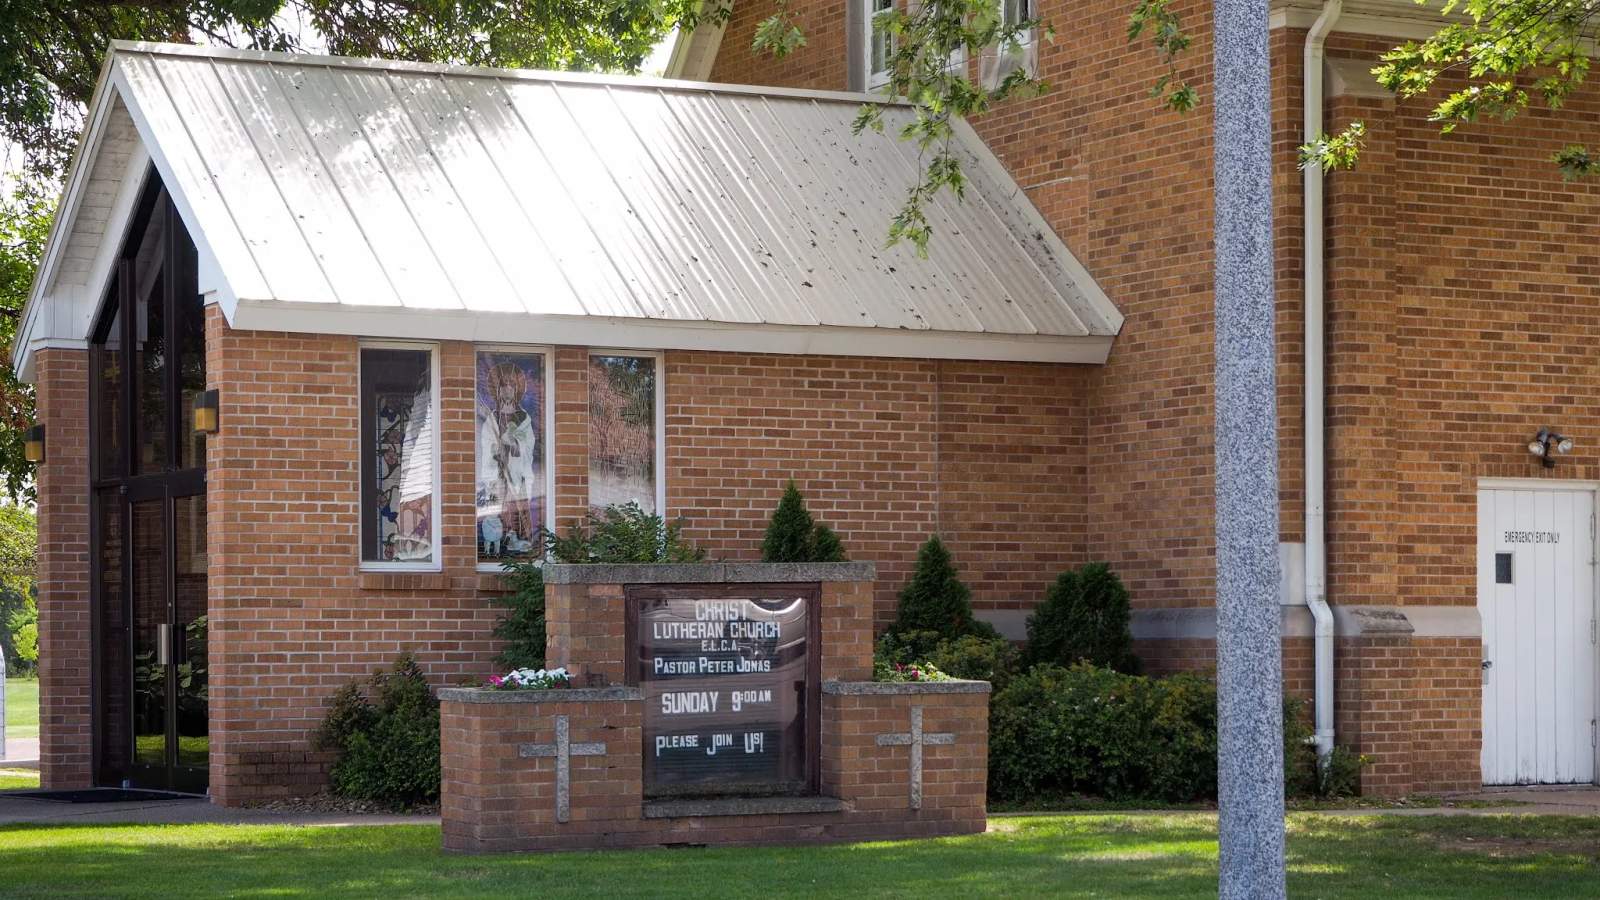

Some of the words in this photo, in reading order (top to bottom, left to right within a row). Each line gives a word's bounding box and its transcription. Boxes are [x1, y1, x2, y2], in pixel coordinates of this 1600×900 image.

[1504, 531, 1534, 544] EMERGENCY
[1536, 532, 1546, 544] EXIT
[1547, 532, 1560, 544] ONLY
[696, 600, 748, 621] CHRIST
[654, 622, 724, 640] LUTHERAN
[730, 622, 780, 639] CHURCH
[654, 657, 696, 674] PASTOR
[699, 657, 734, 673] PETER
[736, 656, 770, 672] JONAS
[662, 692, 720, 714] SUNDAY
[656, 734, 699, 757] PLEASE
[706, 733, 733, 756] JOIN
[744, 733, 764, 754] US!
